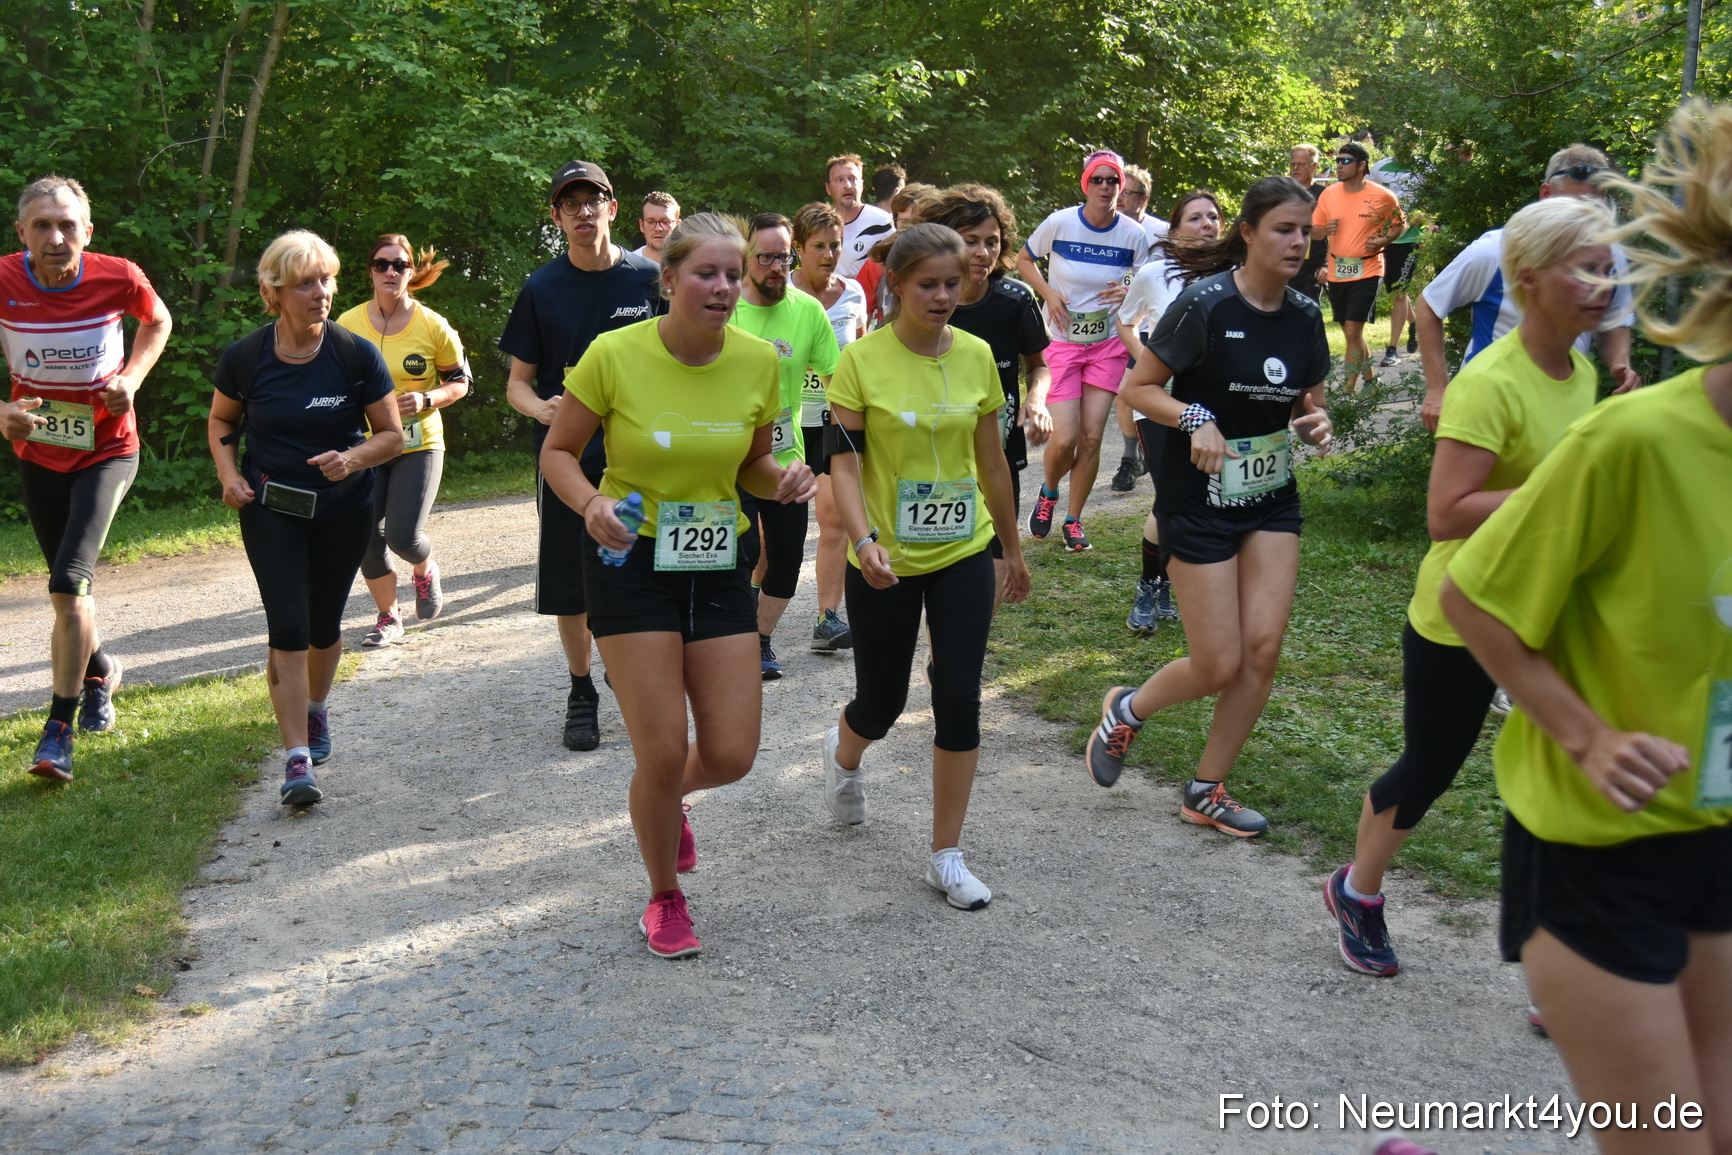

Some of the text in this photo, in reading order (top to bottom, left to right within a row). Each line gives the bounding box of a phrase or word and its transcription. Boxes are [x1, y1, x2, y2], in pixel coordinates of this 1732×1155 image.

[1083, 247, 1120, 258] PLAST
[1336, 264, 1359, 274] 2298
[1072, 321, 1105, 335] 2429
[1224, 330, 1245, 339] JAKO
[42, 343, 106, 360] Petry
[1239, 454, 1276, 480] 102
[908, 501, 967, 525] 1279
[668, 527, 728, 551] 1292
